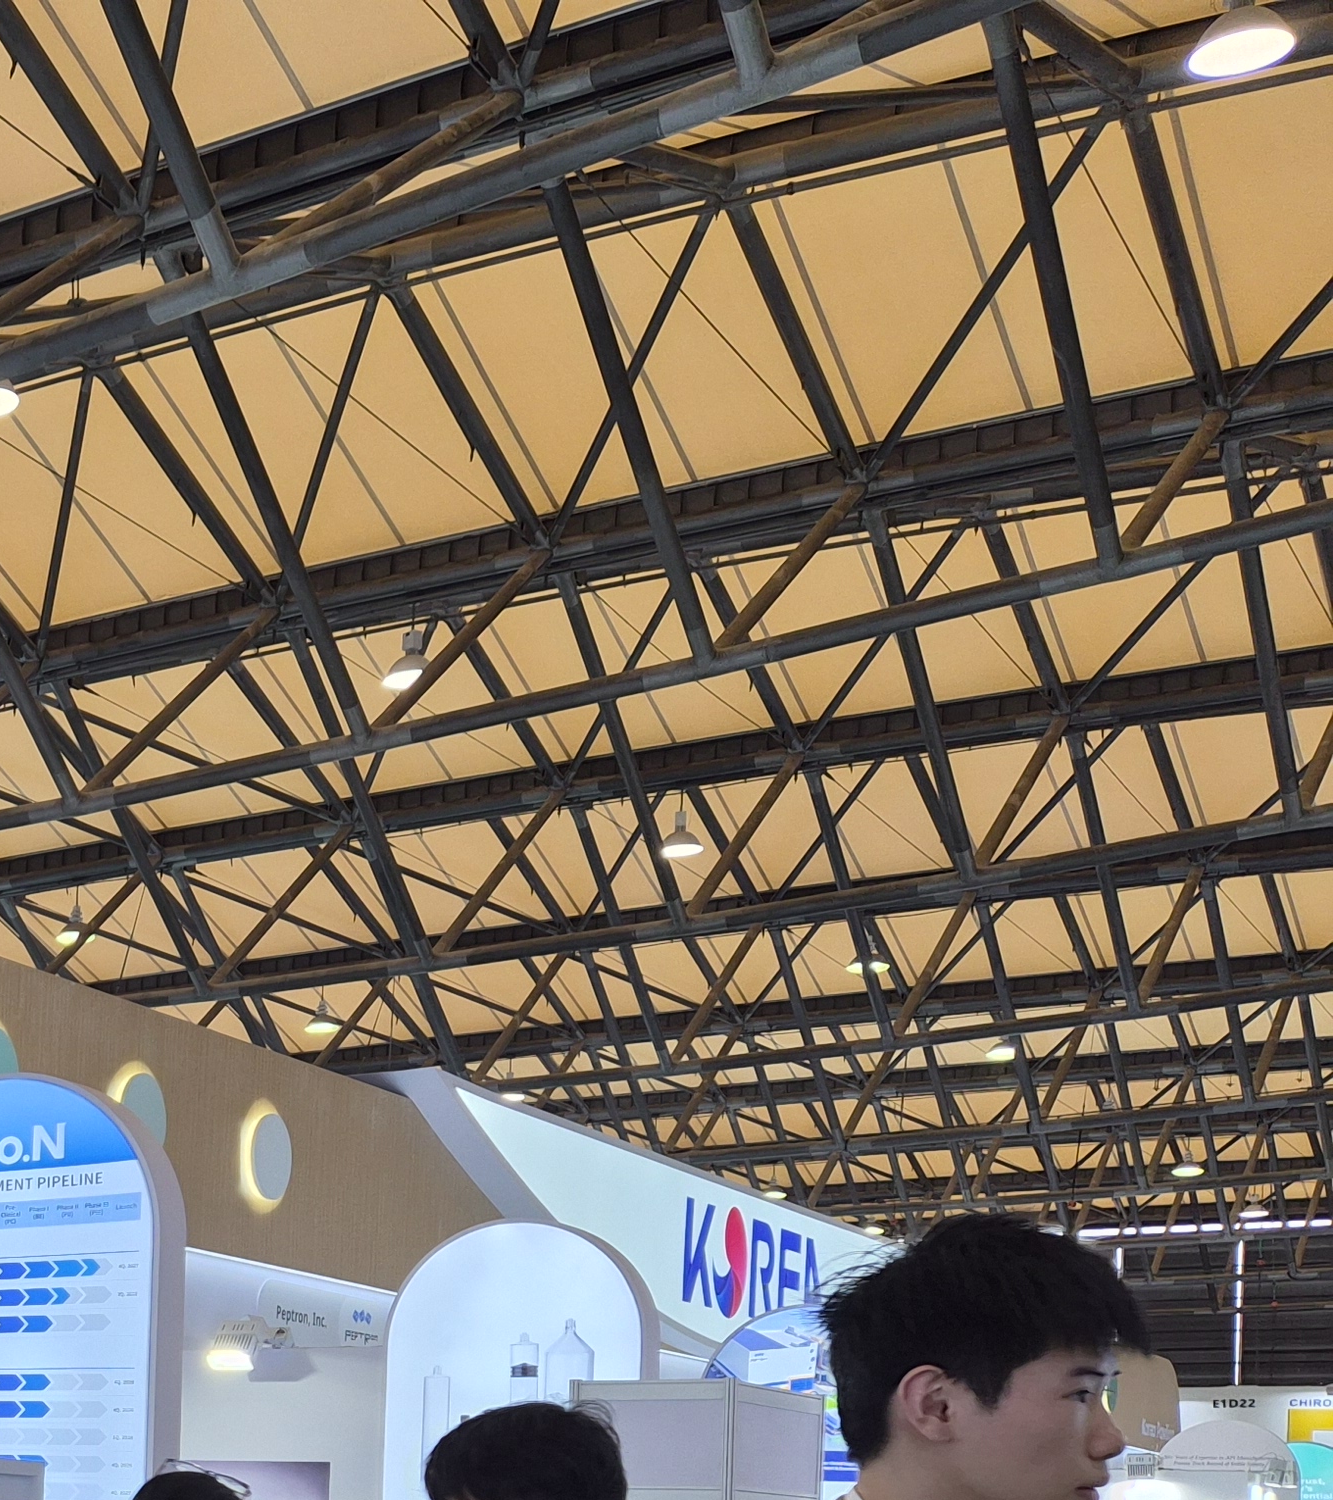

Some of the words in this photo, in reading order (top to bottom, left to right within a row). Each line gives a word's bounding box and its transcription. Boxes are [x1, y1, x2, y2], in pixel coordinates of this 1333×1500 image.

[37, 1172, 103, 1189] PIPELINE
[276, 1305, 311, 1327] Peptron,
[312, 1312, 328, 1328] Inc.
[1213, 1398, 1256, 1408] E1D22
